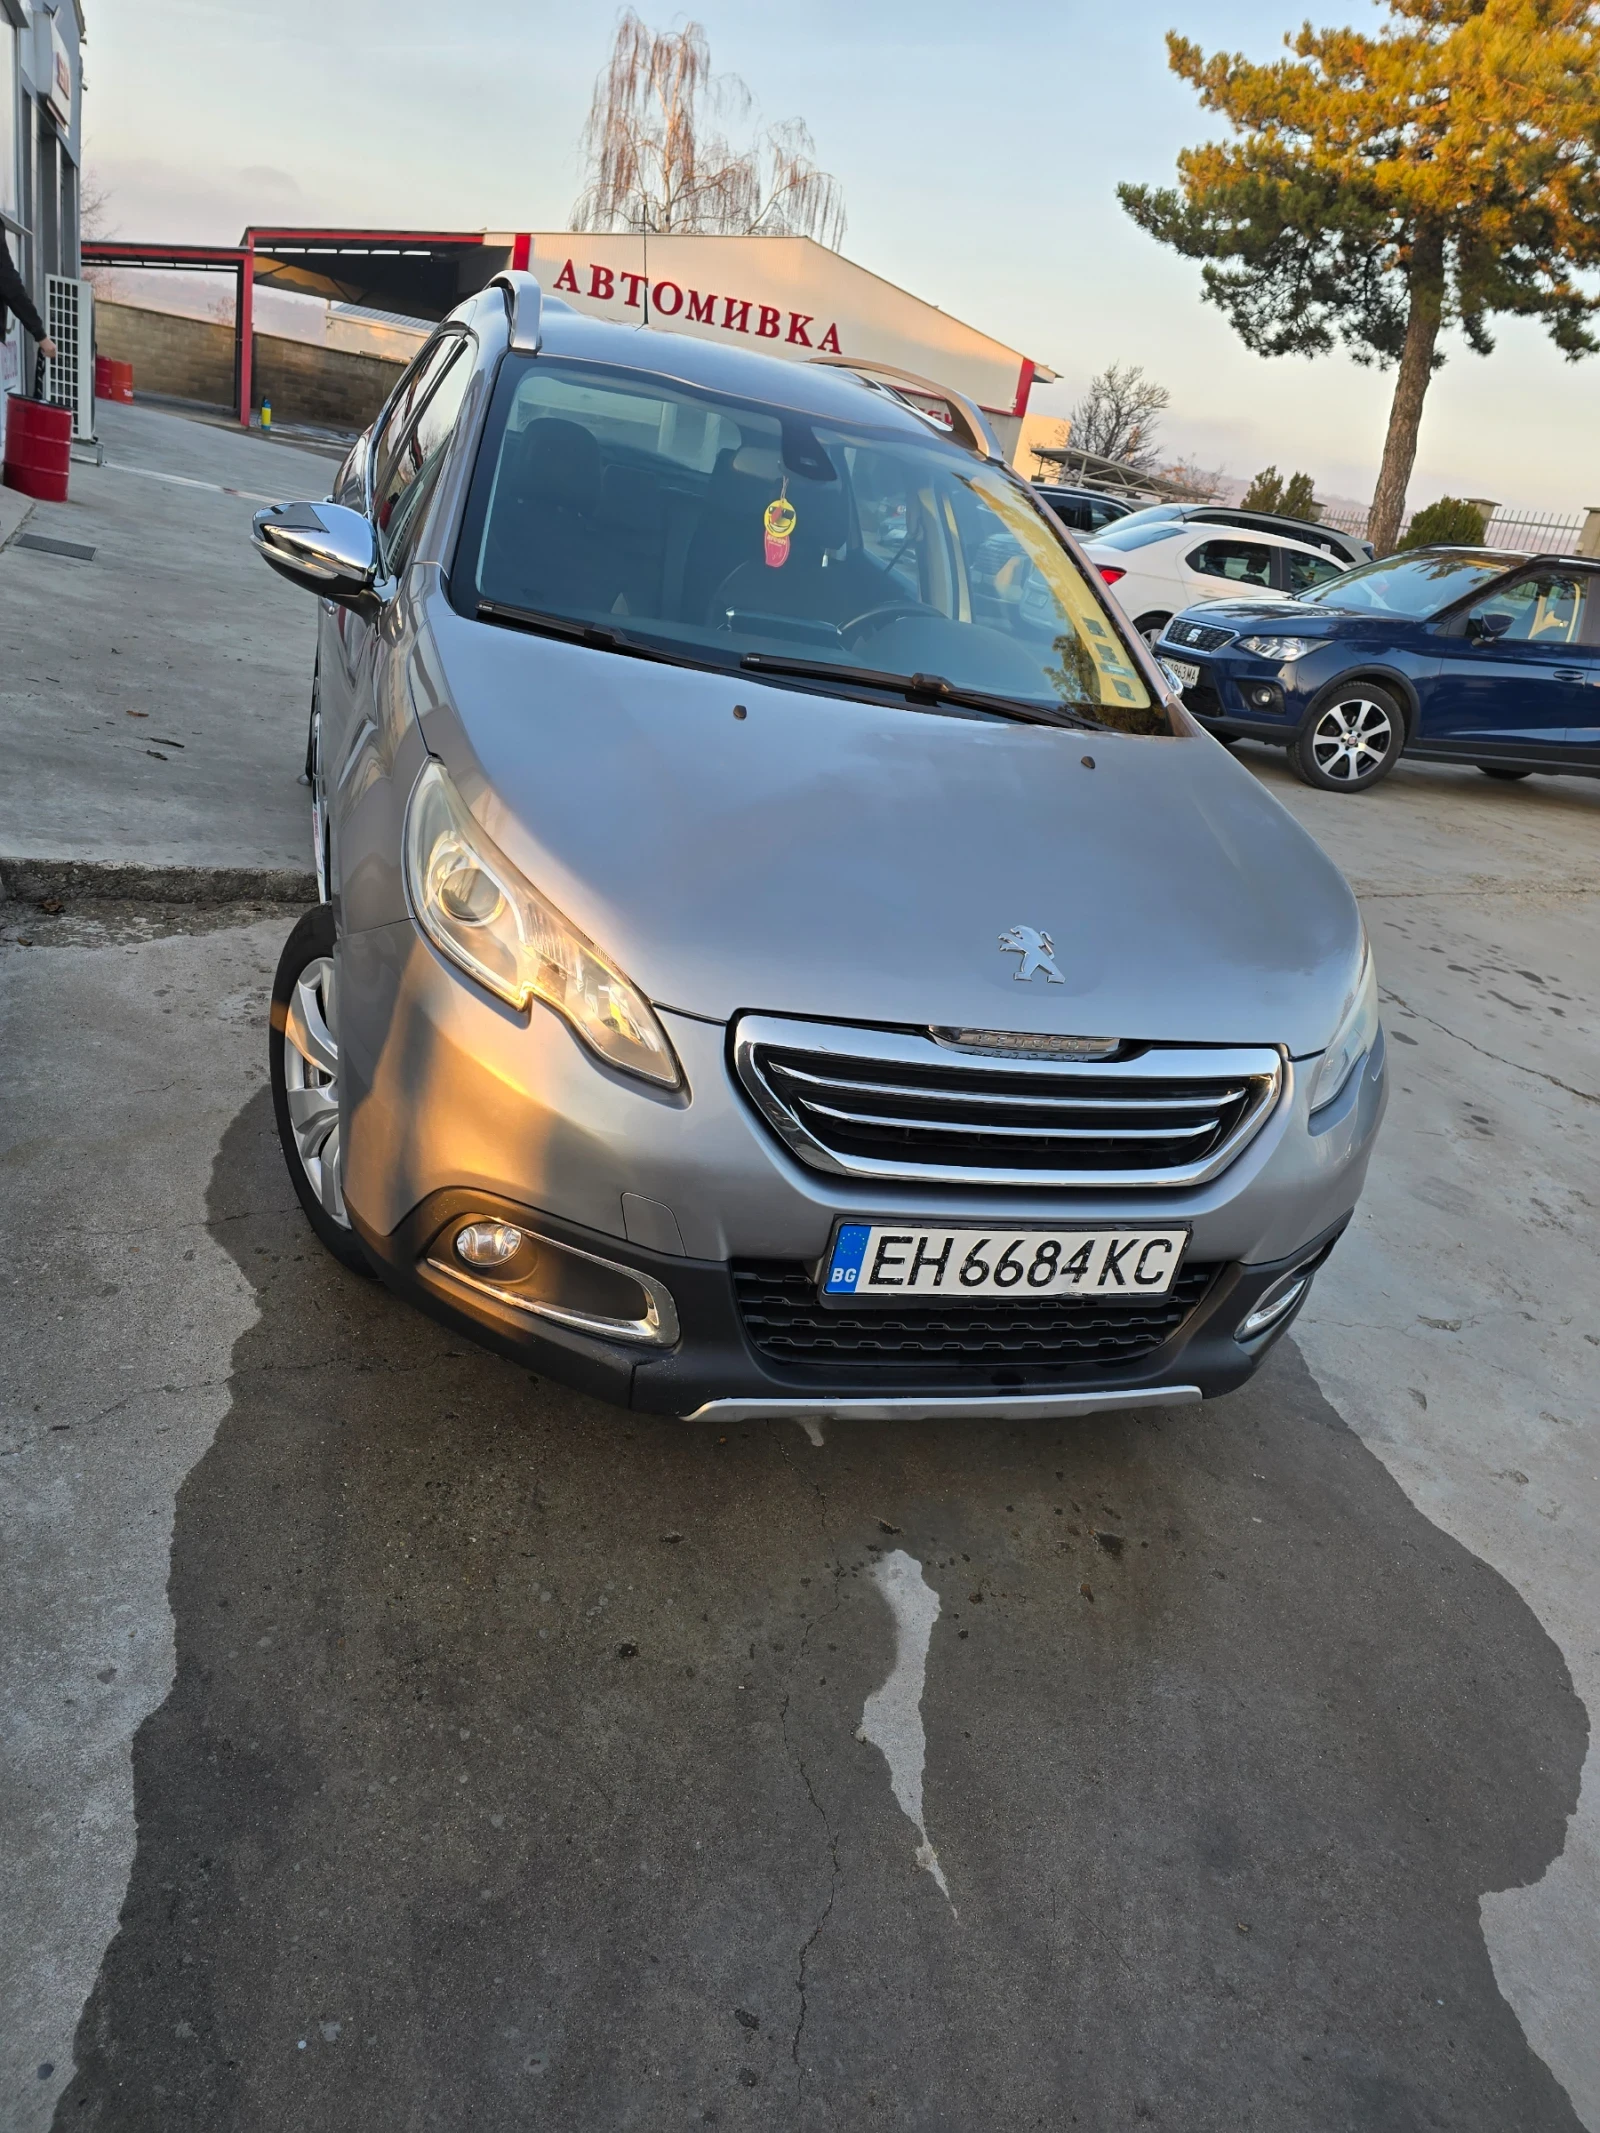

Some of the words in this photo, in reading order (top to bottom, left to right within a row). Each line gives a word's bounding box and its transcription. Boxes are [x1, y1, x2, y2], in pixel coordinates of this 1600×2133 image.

[553, 259, 843, 355] АВТОМИВКА
[977, 1034, 1095, 1052] PEUGEOT
[831, 1267, 857, 1284] BG
